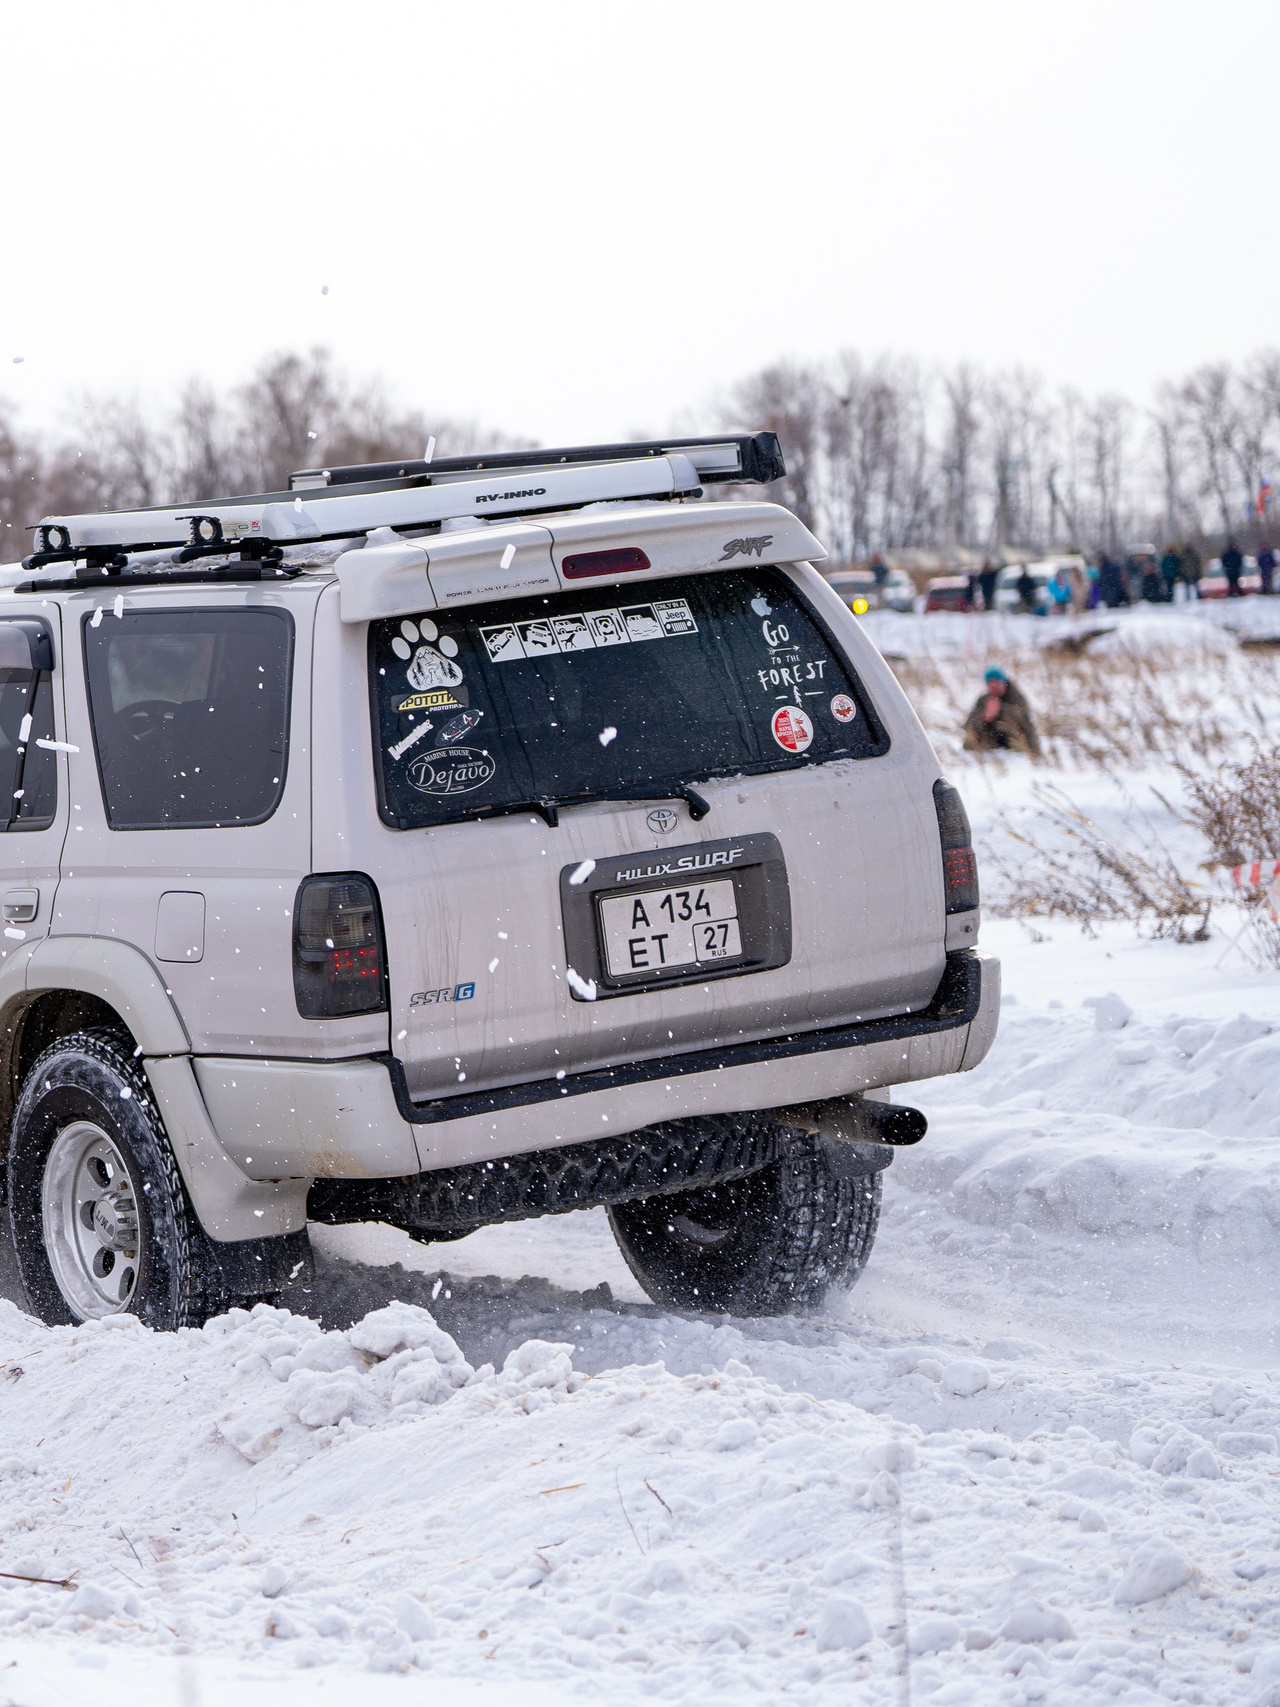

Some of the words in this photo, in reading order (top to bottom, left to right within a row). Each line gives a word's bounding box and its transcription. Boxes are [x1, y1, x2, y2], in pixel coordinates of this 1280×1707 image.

[476, 488, 547, 503] RV-INNO
[718, 535, 773, 562] SURF
[665, 611, 686, 620] Jeep
[762, 620, 789, 646] GO
[771, 656, 782, 665] TO
[786, 655, 800, 663] THE
[757, 660, 827, 691] FOREST
[423, 751, 448, 763] MARINE
[449, 749, 470, 757] HOUSE
[412, 762, 489, 792] Dejavo
[616, 863, 672, 882] HILUX
[676, 848, 745, 871] SURF
[660, 888, 712, 924] 134
[703, 923, 729, 950] 27
[711, 949, 727, 957] RUS
